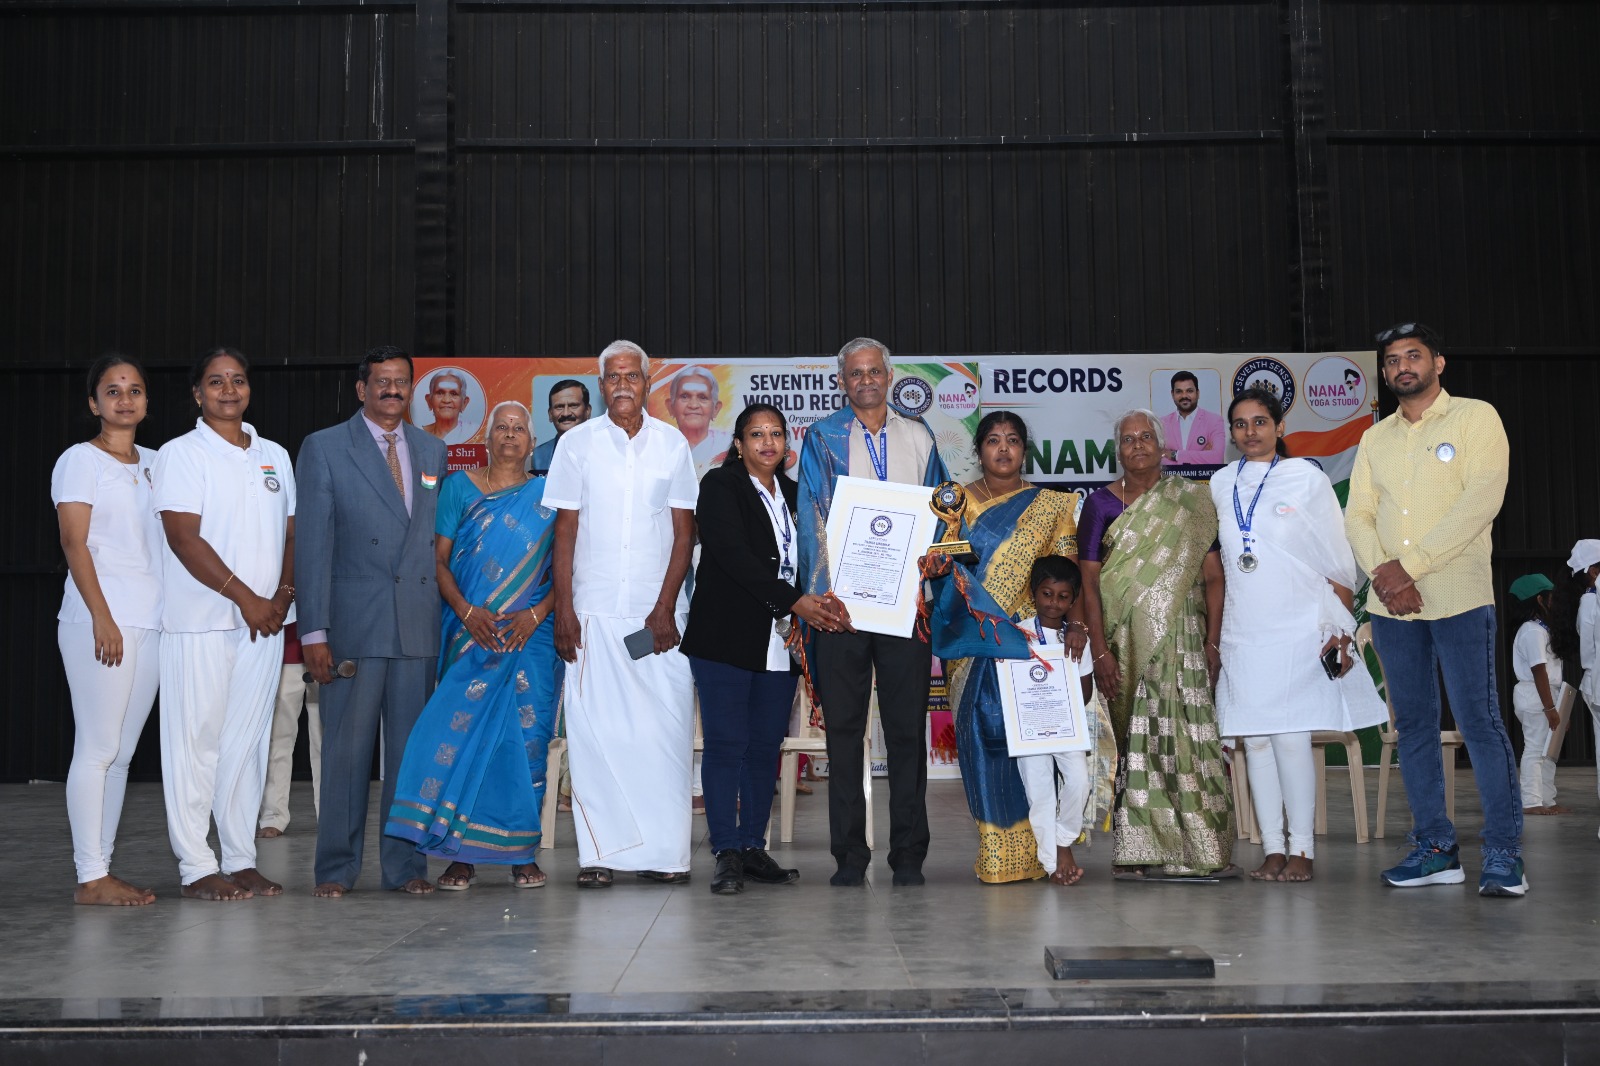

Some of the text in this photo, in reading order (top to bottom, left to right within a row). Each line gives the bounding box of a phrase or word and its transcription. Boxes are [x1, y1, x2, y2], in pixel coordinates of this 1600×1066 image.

[993, 367, 1123, 394] RECORDS
[1235, 361, 1292, 387] SEVENTH SENSE
[750, 373, 824, 391] SEVENTH
[893, 378, 931, 395] SEVENTH SENSE
[938, 393, 967, 403] NANA
[1308, 384, 1347, 398] NANA
[1309, 398, 1360, 407] YOGA STUDIO
[455, 447, 476, 457] Shri
